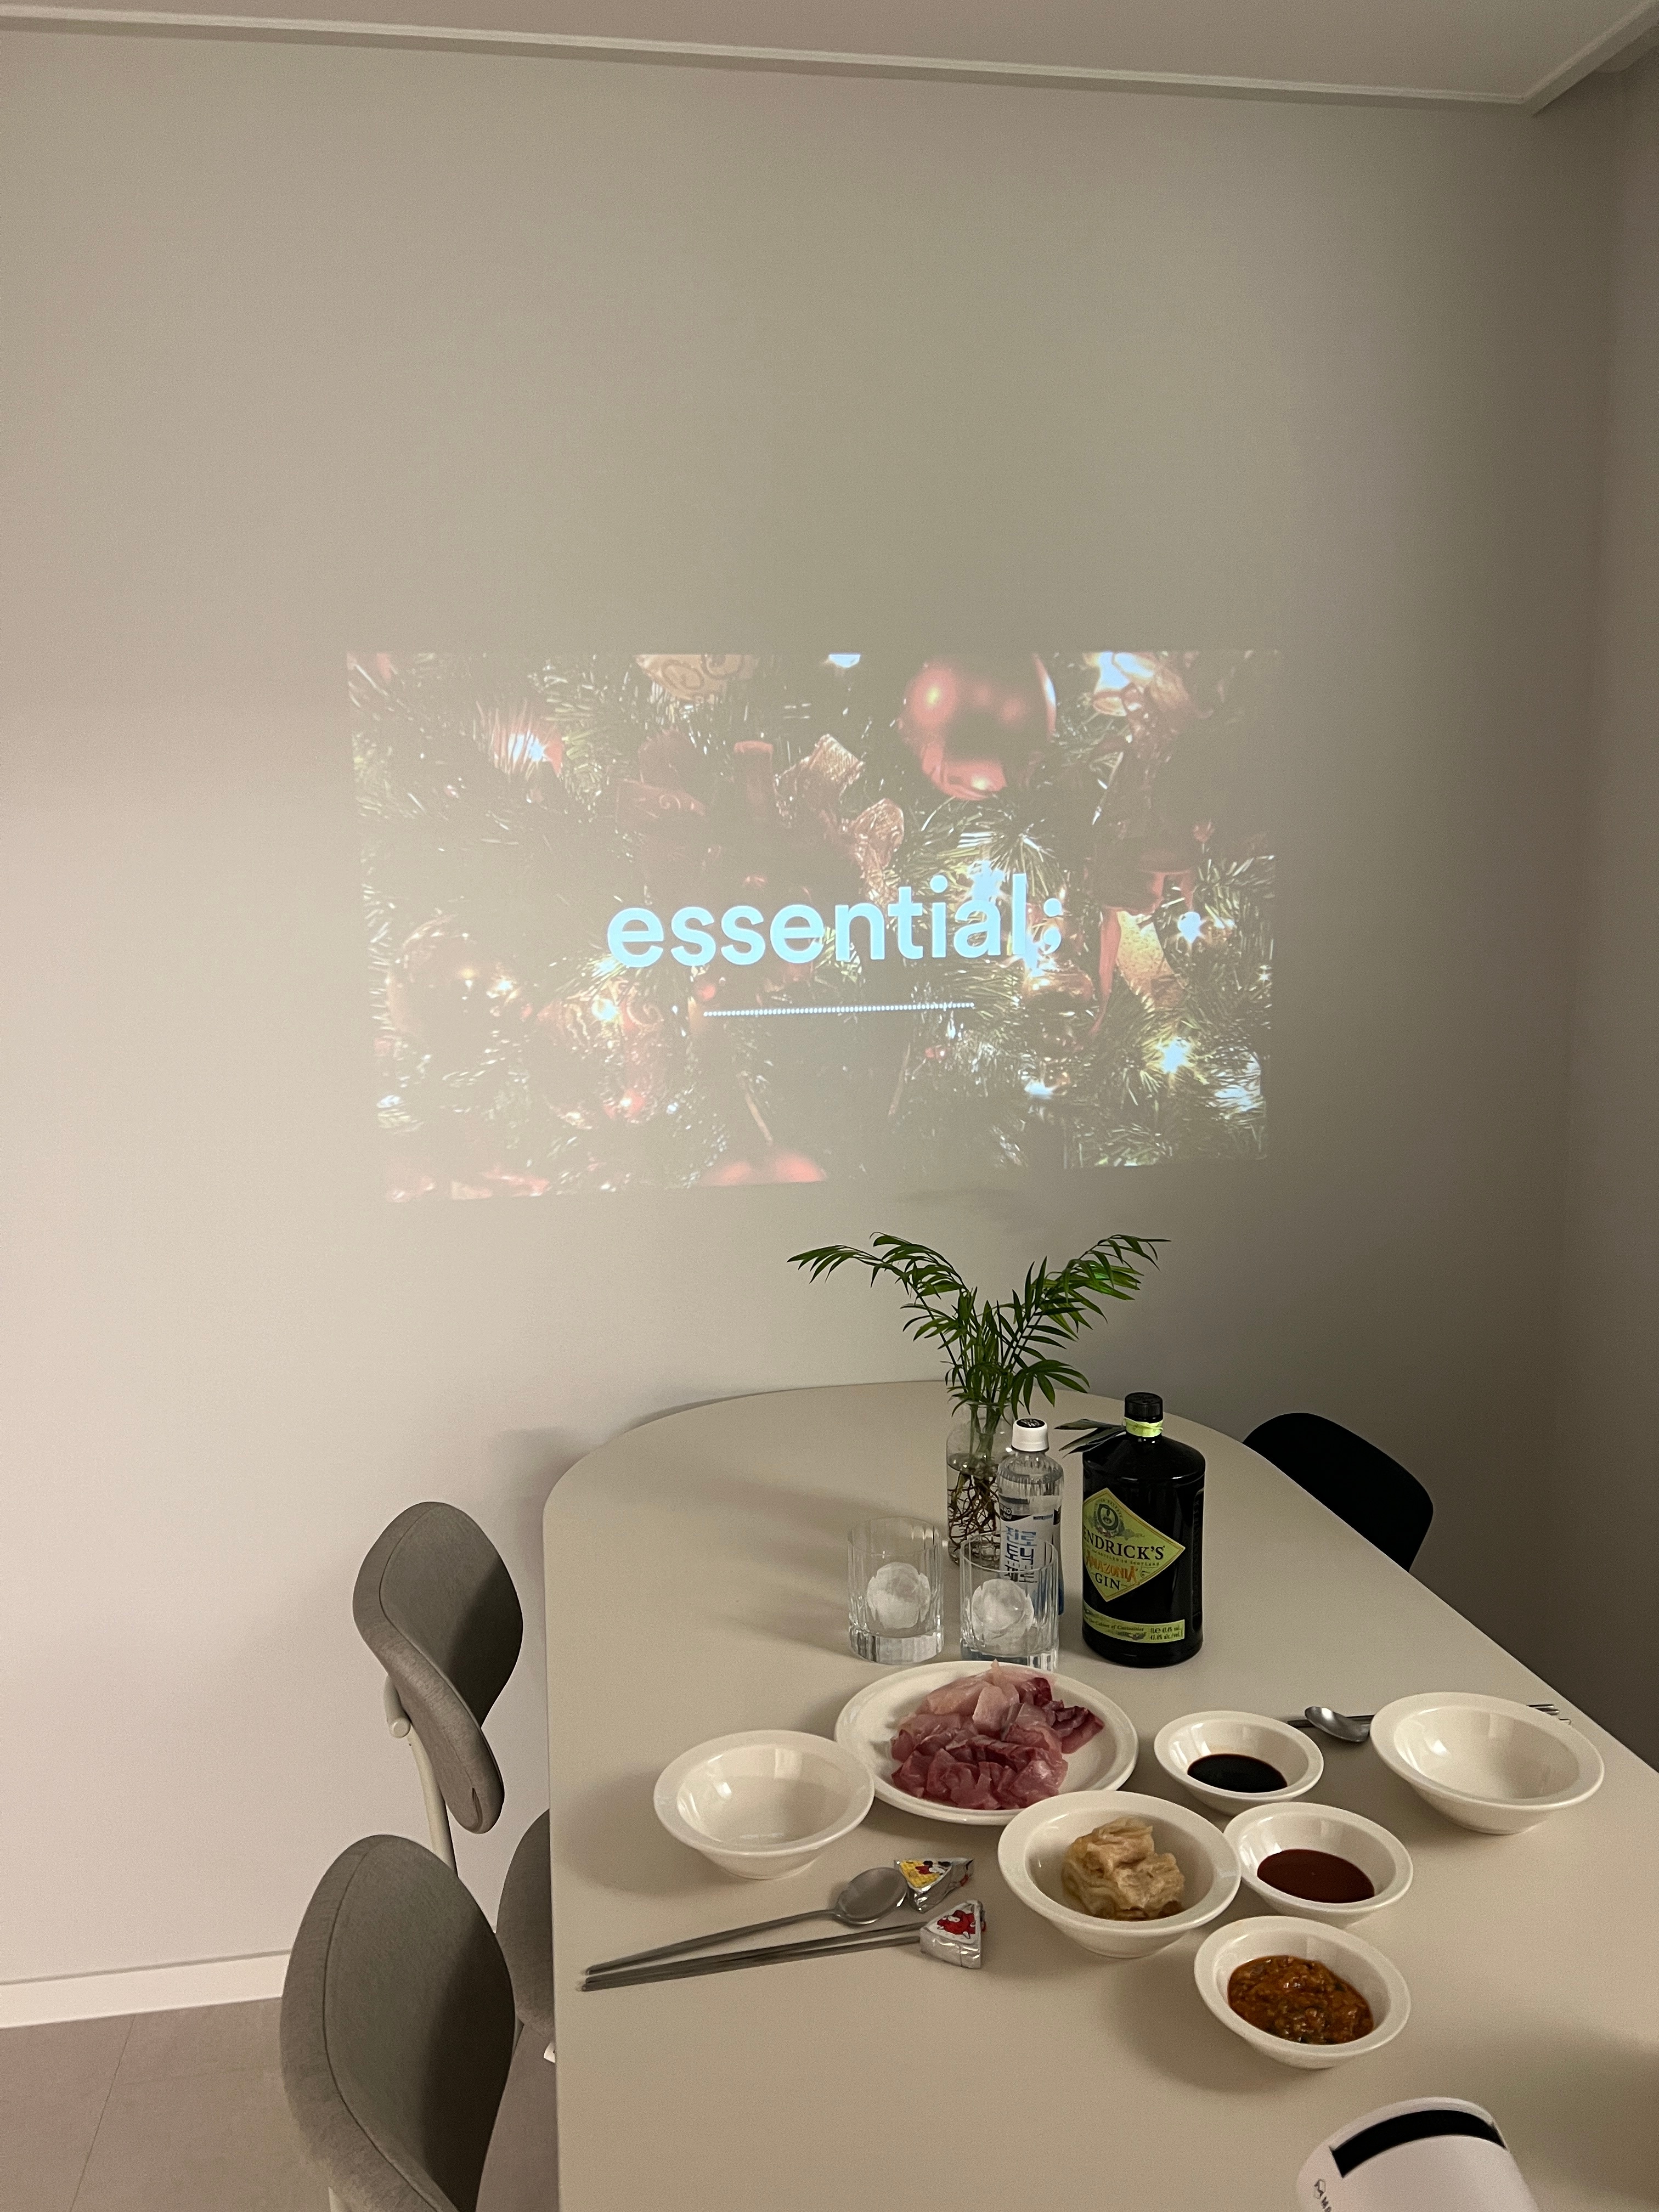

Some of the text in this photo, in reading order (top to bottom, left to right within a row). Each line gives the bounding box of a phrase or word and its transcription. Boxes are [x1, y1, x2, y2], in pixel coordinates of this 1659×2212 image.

[607, 873, 1062, 967] essential;
[1005, 1526, 1037, 1546] 진로
[1083, 1527, 1164, 1560] ENDRICK'S
[1005, 1543, 1034, 1565] 토닉
[1095, 1572, 1120, 1590] GIN
